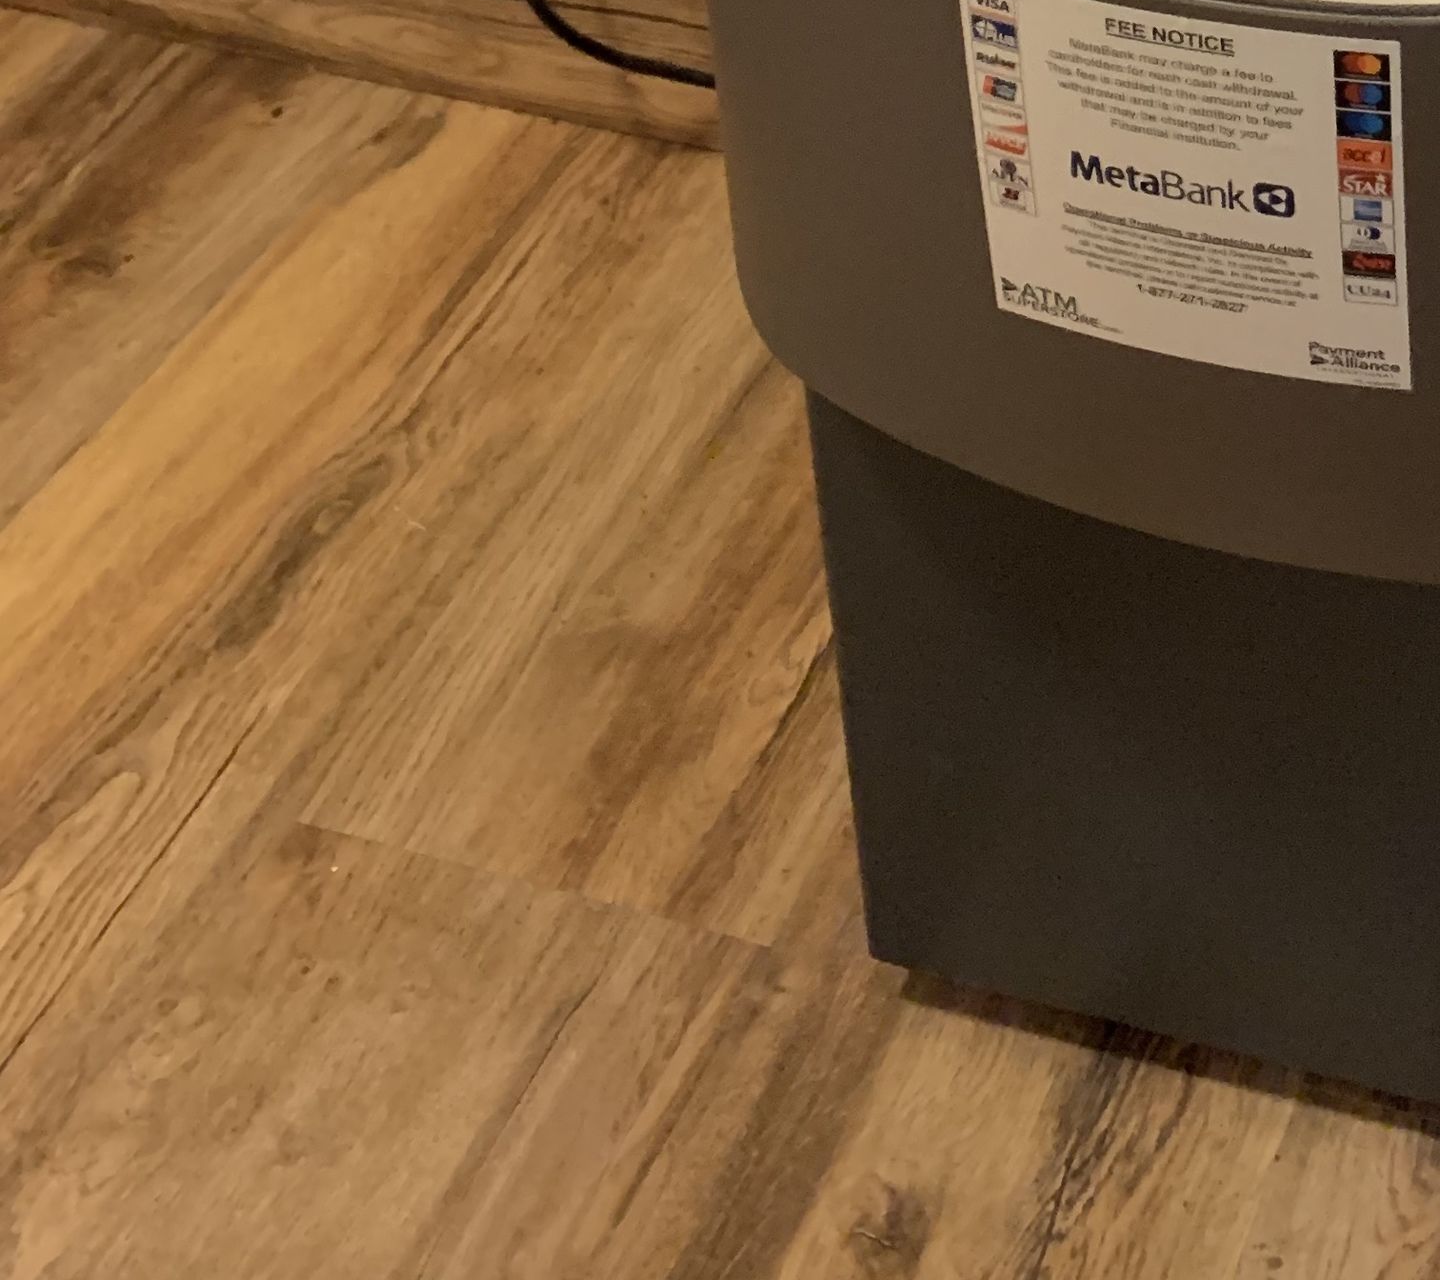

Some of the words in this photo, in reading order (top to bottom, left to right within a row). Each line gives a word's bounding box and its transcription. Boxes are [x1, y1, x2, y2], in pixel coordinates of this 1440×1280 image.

[1105, 17, 1146, 39] FEE
[1152, 27, 1235, 53] NOTICE
[1047, 49, 1123, 73] cardholders
[1127, 64, 1144, 76] for
[1185, 78, 1217, 89] cash
[1139, 54, 1167, 67] may
[1171, 60, 1218, 76] charge
[1222, 68, 1231, 77] a
[1234, 68, 1256, 80] fee
[1045, 60, 1073, 75] This
[1076, 68, 1096, 81] fee
[1100, 73, 1110, 84] is
[1114, 78, 1156, 93] added
[1159, 85, 1172, 97] to
[1175, 89, 1197, 100] the
[1201, 95, 1251, 109] amount
[1256, 102, 1270, 111] of
[1273, 106, 1304, 116] your
[1057, 80, 1126, 102] withdrawal
[1129, 96, 1154, 108] and
[1189, 108, 1241, 121] addition
[1246, 114, 1259, 125] to
[1263, 116, 1293, 129] fees
[1080, 98, 1105, 111] that
[1109, 106, 1136, 120] may
[1160, 116, 1215, 132] charged
[1219, 125, 1235, 138] by
[1239, 130, 1270, 141] your
[1110, 118, 1169, 139] Financial
[1070, 150, 1250, 213] MetaBank
[1343, 173, 1388, 196] STAR
[1021, 282, 1078, 315] ATM
[1308, 341, 1386, 360] Payment
[1331, 355, 1400, 373] Alliance
